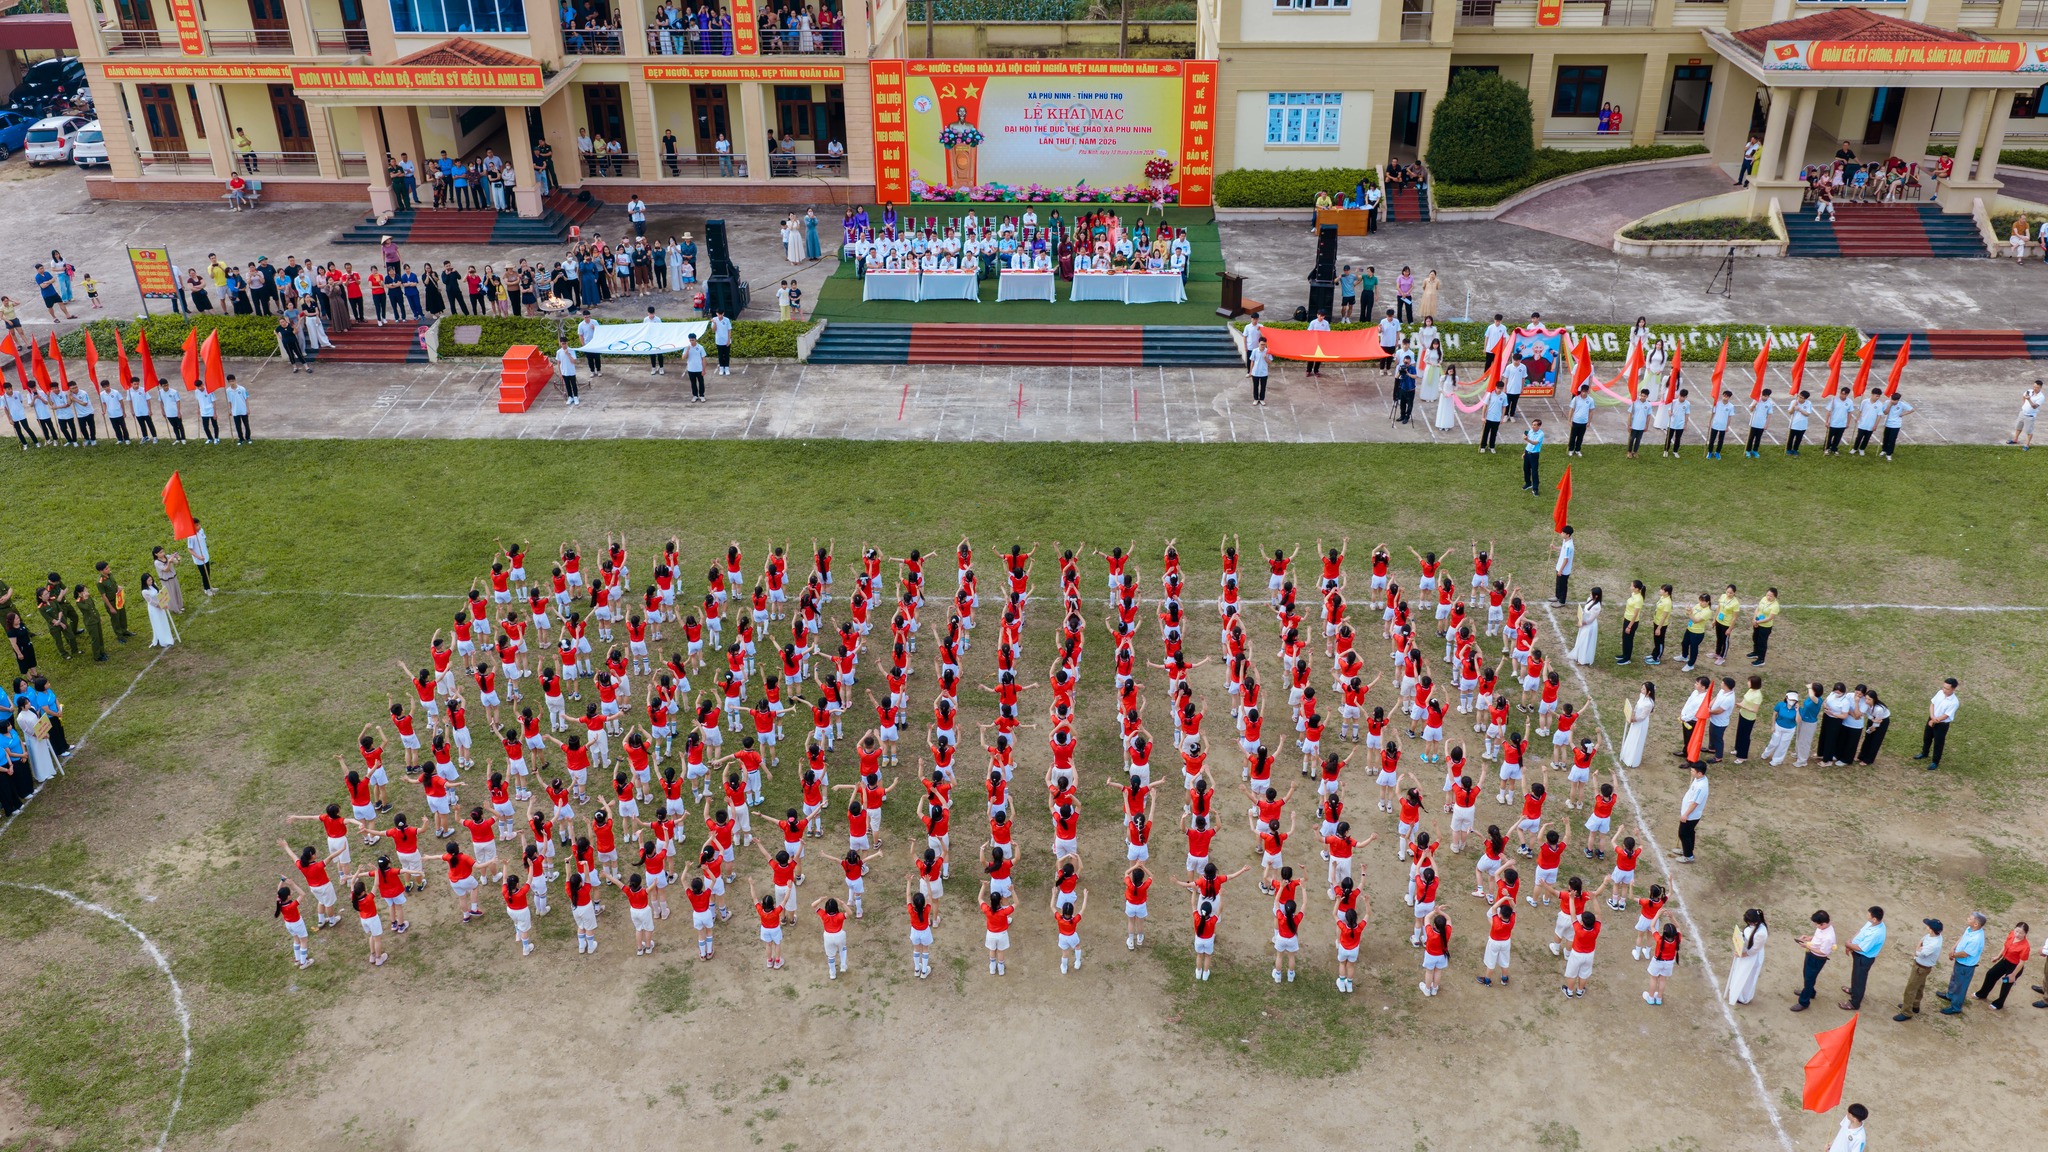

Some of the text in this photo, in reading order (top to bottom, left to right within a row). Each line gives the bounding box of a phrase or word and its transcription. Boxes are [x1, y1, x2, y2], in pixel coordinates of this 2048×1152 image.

[1821, 46, 2010, 66] ĐOÀN KẾT, KỶ CƯƠNG, ĐỘT PHÁ, SÁNG TẠO, QUYẾT THẮNG
[648, 68, 840, 79] ĐẸP NGƯỜI, ĐẸP DOANH TRẠI, ĐẸP TÌNH QUÂN DÂN
[928, 62, 951, 73] NƯỚC
[952, 62, 975, 75] CỘNG
[995, 62, 1006, 73] XÃ
[1009, 62, 1022, 75] HỘI
[1024, 61, 1041, 73] CHỦ
[1042, 62, 1068, 73] NGHĨA
[1069, 62, 1087, 75] VIỆT
[1088, 64, 1108, 73] NAM
[1109, 63, 1134, 73] MUÔN
[1136, 63, 1158, 73] NĂM!
[300, 69, 536, 88] ĐƠN VỊ LÀ NHÀ, CÁN BỘ, CHIẾN SỸ ĐỀU LÀ ANH EM
[1028, 91, 1037, 100] XÃ
[1078, 91, 1093, 100] TỈNH
[1110, 93, 1123, 101] THỌ
[1024, 102, 1124, 122] LỄ KHAI MẠC
